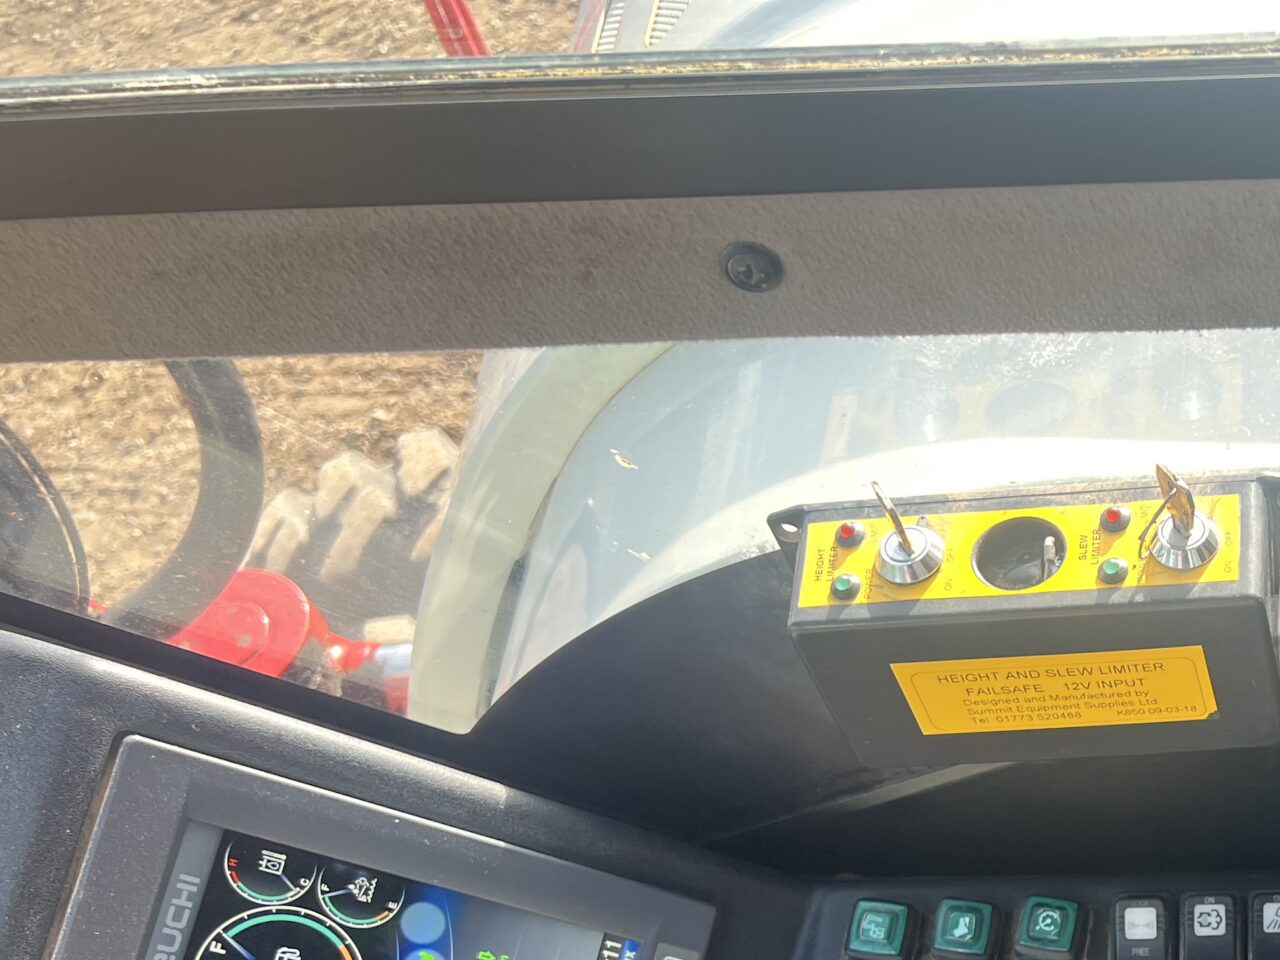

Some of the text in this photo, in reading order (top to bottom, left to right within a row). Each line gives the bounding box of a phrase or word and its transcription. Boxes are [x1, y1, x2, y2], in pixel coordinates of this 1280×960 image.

[1078, 534, 1089, 561] SLEW
[1090, 529, 1101, 566] LIMITER
[814, 548, 826, 582] HEIGHT
[826, 546, 839, 582] LIMITER
[936, 661, 1166, 685] HEIGHT AND SLEW LIMITER
[965, 676, 1147, 697] FAILSAFE 12V INPUT
[962, 689, 1150, 707] Designed and Manufactured by
[967, 697, 1158, 716] Summit Equipment Supplies Ltd
[228, 857, 239, 867] H
[299, 878, 310, 887] C
[320, 883, 330, 892] F
[388, 901, 398, 909] E
[1203, 896, 1216, 904] ON
[209, 940, 227, 955] F
[1131, 947, 1150, 957] FREE
